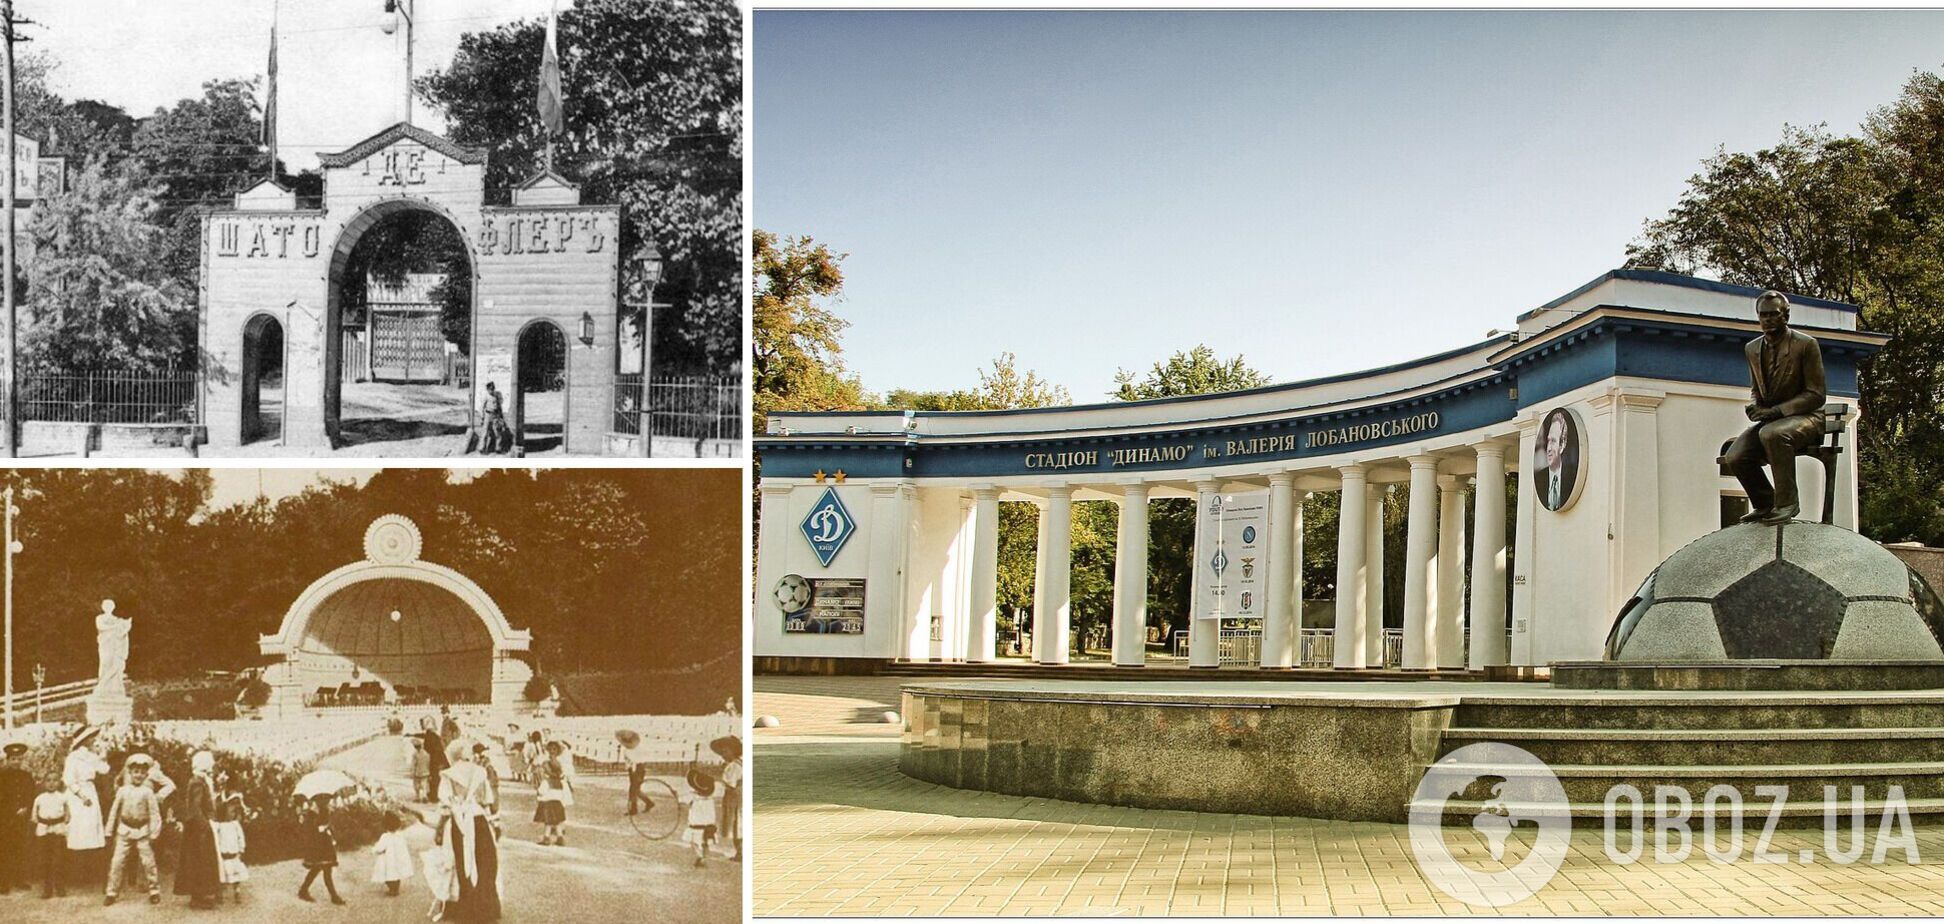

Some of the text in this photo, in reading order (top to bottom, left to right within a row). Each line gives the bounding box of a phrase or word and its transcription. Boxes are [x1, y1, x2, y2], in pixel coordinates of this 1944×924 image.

[378, 150, 427, 187] ДЕ
[217, 222, 320, 259] ШАТО
[477, 216, 605, 256] ФЛЕРЪ
[1024, 451, 1098, 470] СТАДІОН
[1226, 434, 1296, 457] ВАЛЕРІЯ
[1305, 411, 1439, 449] ЛОБАНОВСЬКОГО
